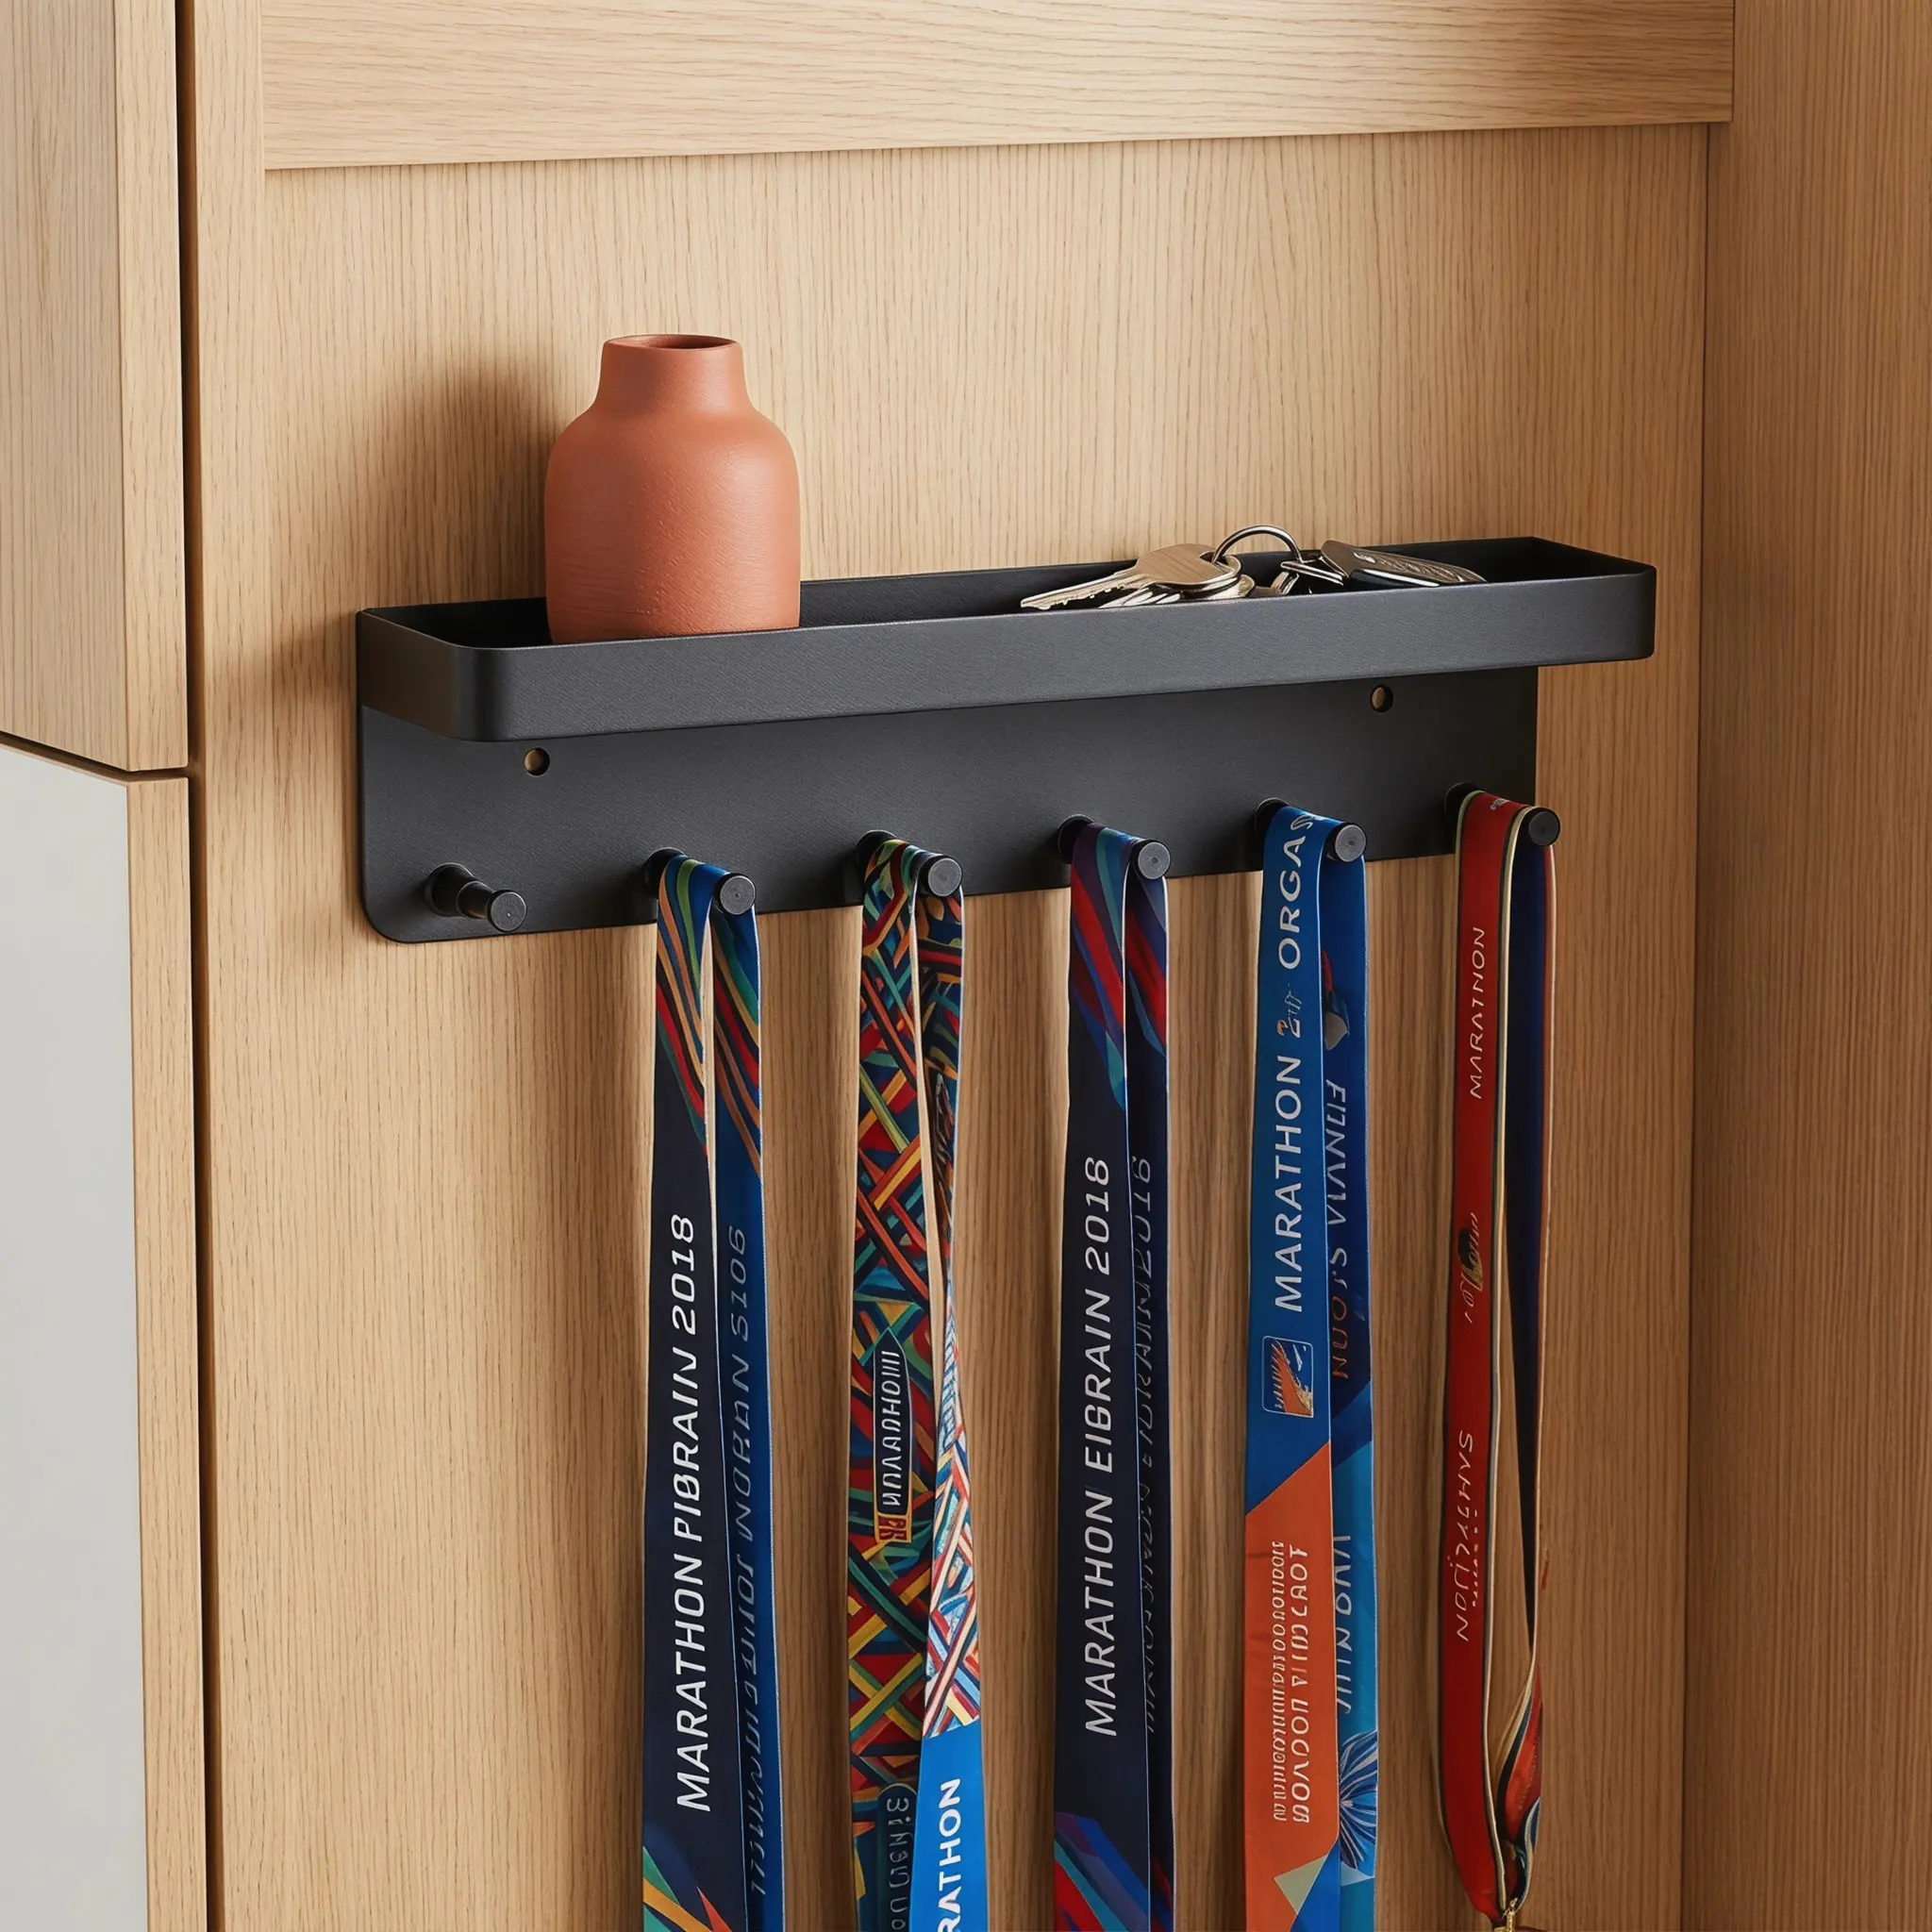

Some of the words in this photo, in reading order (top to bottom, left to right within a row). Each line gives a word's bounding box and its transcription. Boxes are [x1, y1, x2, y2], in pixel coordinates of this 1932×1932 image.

[671, 1213, 697, 1336] 2018
[1274, 1055, 1303, 1313] MARATHON
[673, 1554, 710, 1812] MARATHON
[1084, 1489, 1117, 1737] MARATHON
